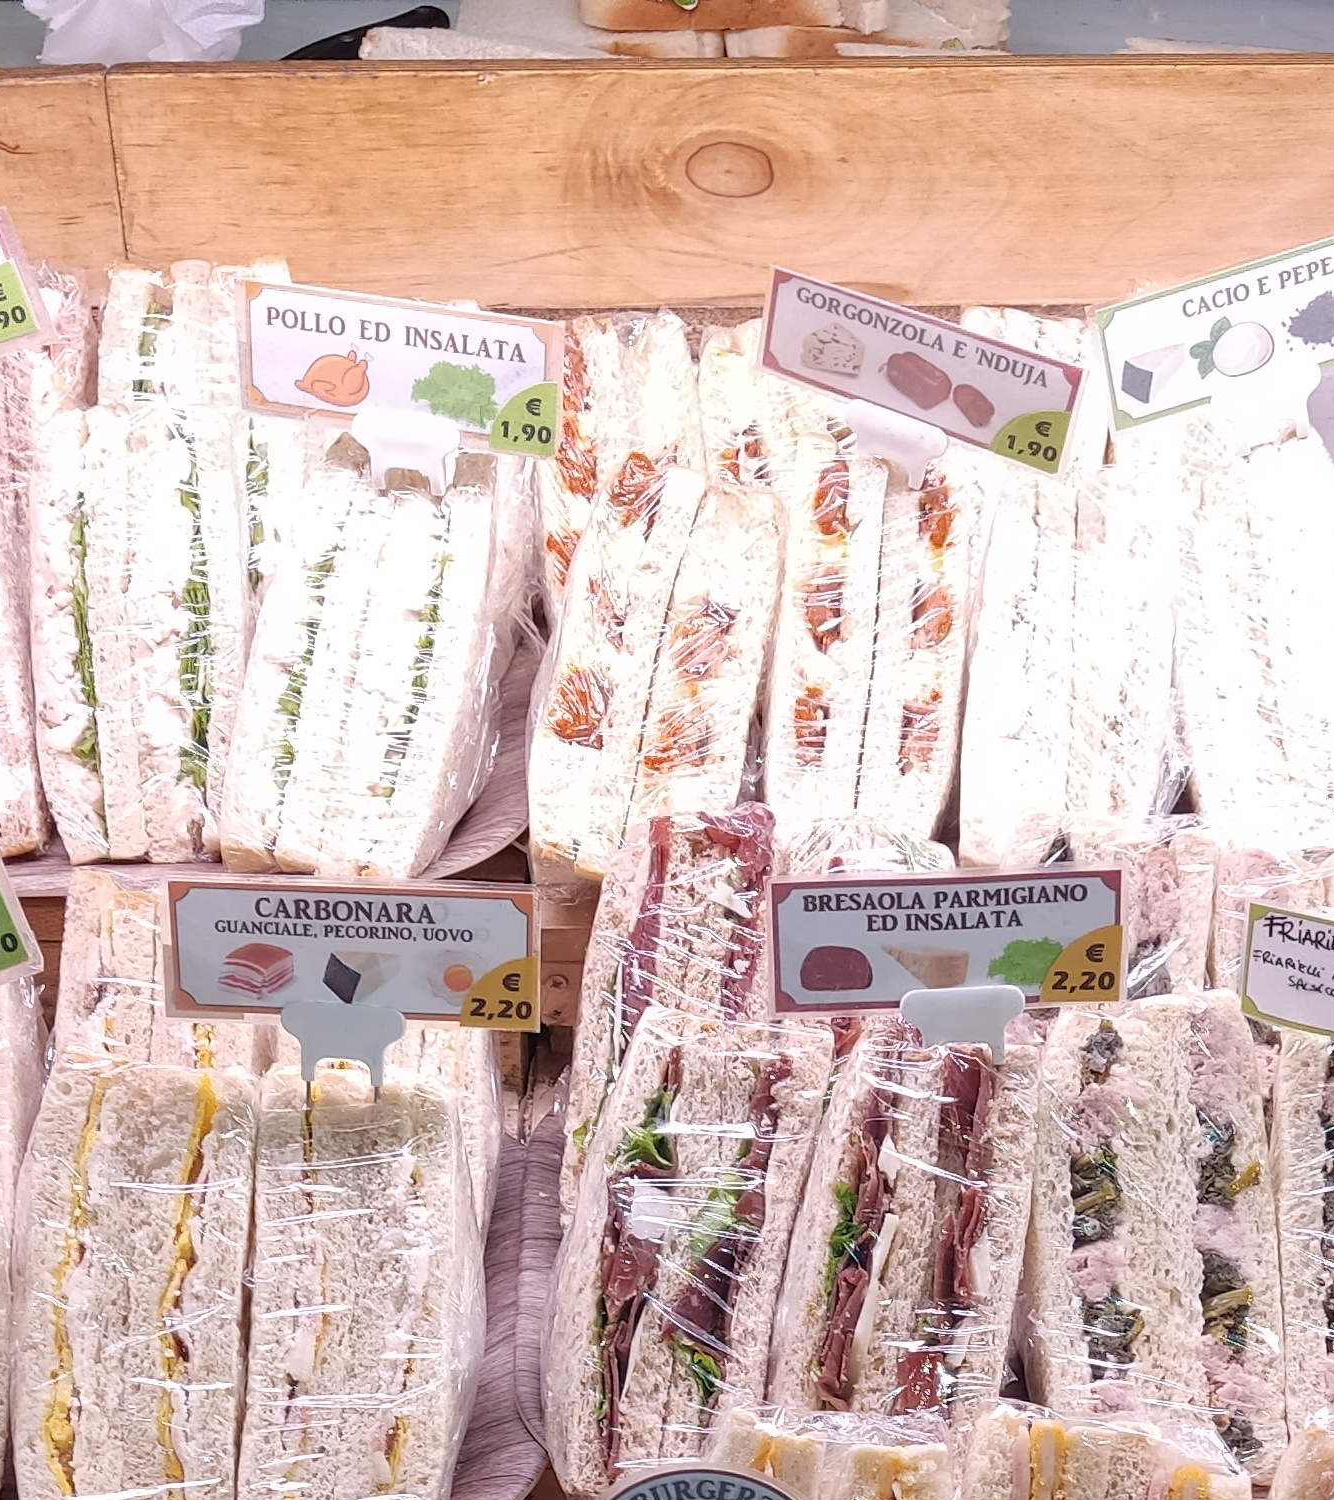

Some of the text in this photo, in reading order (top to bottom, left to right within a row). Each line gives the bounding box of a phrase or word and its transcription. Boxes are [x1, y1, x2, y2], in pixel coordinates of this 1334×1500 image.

[1182, 256, 1334, 318] CACIO E PEPE
[266, 306, 527, 364] POLLO ED INSALATA
[796, 286, 1048, 388] GORGONZOLA E 'NDUJA
[525, 397, 542, 416] €
[500, 420, 551, 444] 1,90
[1035, 420, 1052, 438] €
[1006, 434, 1057, 462] 1,90
[802, 883, 1088, 913] BRESAOLA PARMIGIANO
[254, 897, 436, 925] CARBONARA
[866, 909, 1023, 933] ED INSALATA
[214, 920, 474, 943] GUANCIALE, PECORINO, UOVO
[1085, 944, 1105, 962] €
[502, 973, 521, 992] €
[1051, 971, 1115, 994] 2,20
[470, 998, 532, 1021] 2,20
